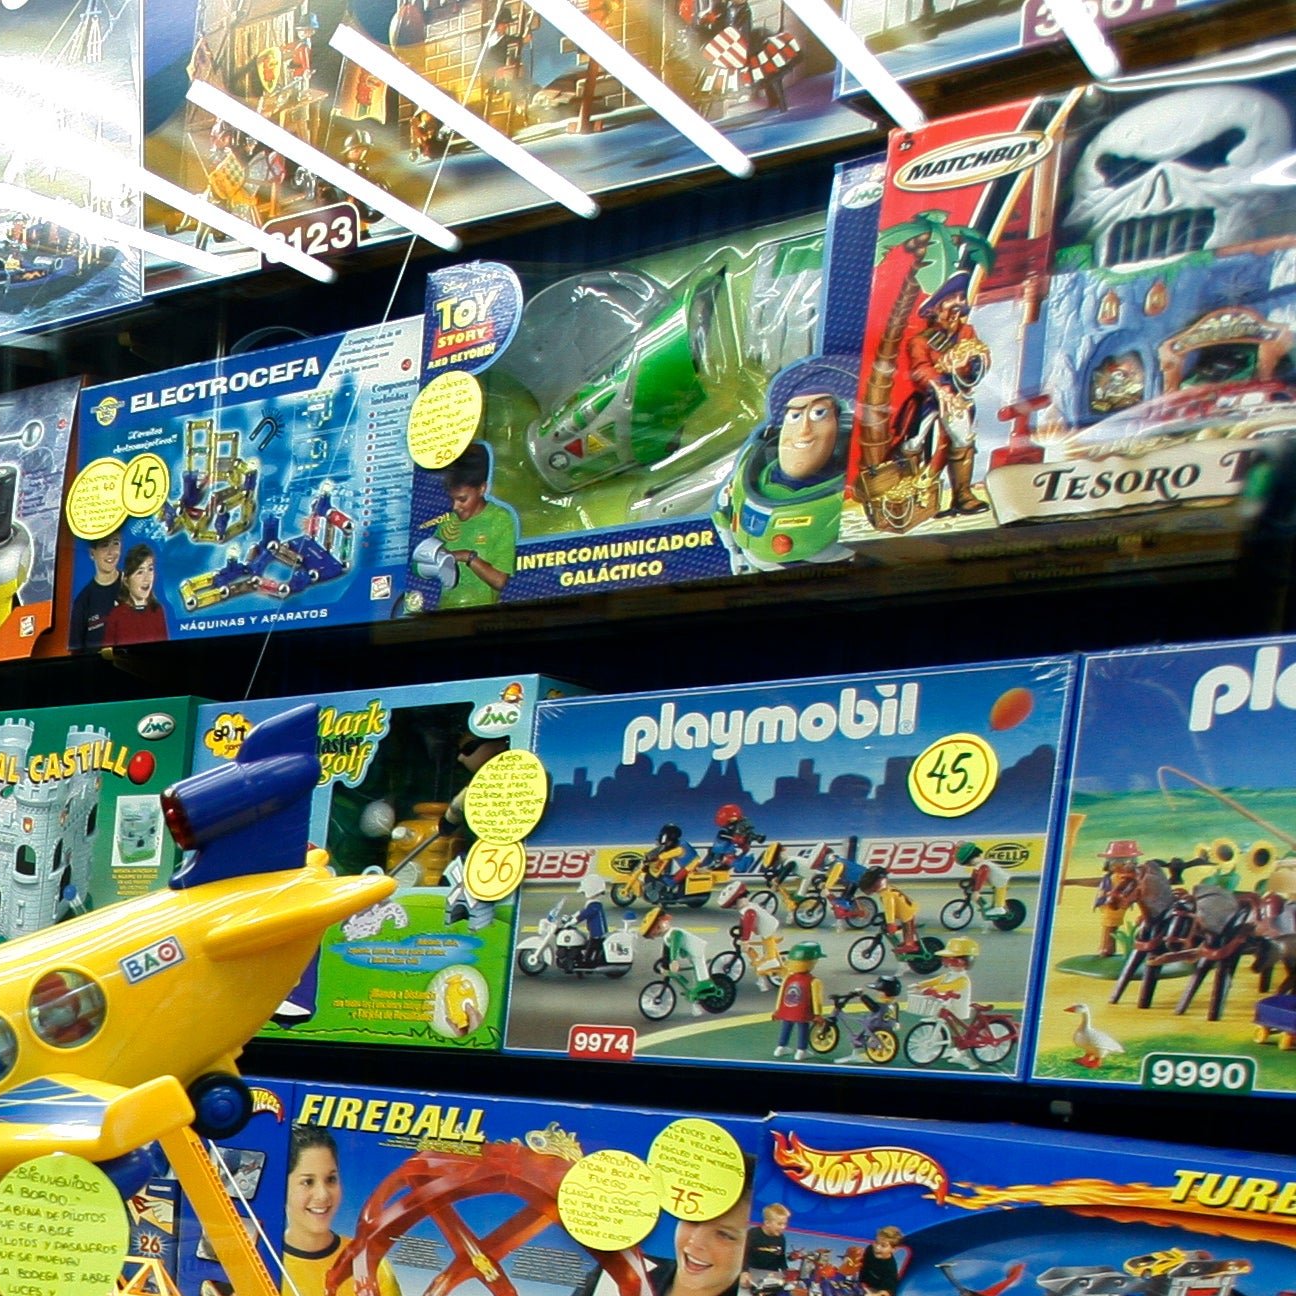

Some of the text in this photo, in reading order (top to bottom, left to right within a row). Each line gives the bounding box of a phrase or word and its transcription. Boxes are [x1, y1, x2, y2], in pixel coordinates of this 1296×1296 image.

[908, 139, 1041, 181] MATCHBOX
[435, 288, 499, 331] TOY
[437, 326, 487, 349] STORY
[130, 356, 320, 413] ELECTROCEFA
[1034, 463, 1201, 504] TESORO
[516, 530, 714, 570] INTERCOMUNICADOR
[560, 558, 663, 588] GALÁCTICO
[179, 616, 245, 632] MÁQUINAS
[260, 608, 329, 624] APARATOS
[623, 682, 920, 765] playmobil
[476, 849, 514, 884] 36
[860, 839, 957, 876] BBS
[573, 1031, 629, 1055] 9974
[1152, 1059, 1246, 1089] 9990
[298, 1093, 486, 1143] FIREBALL
[139, 1234, 161, 1254] 26
